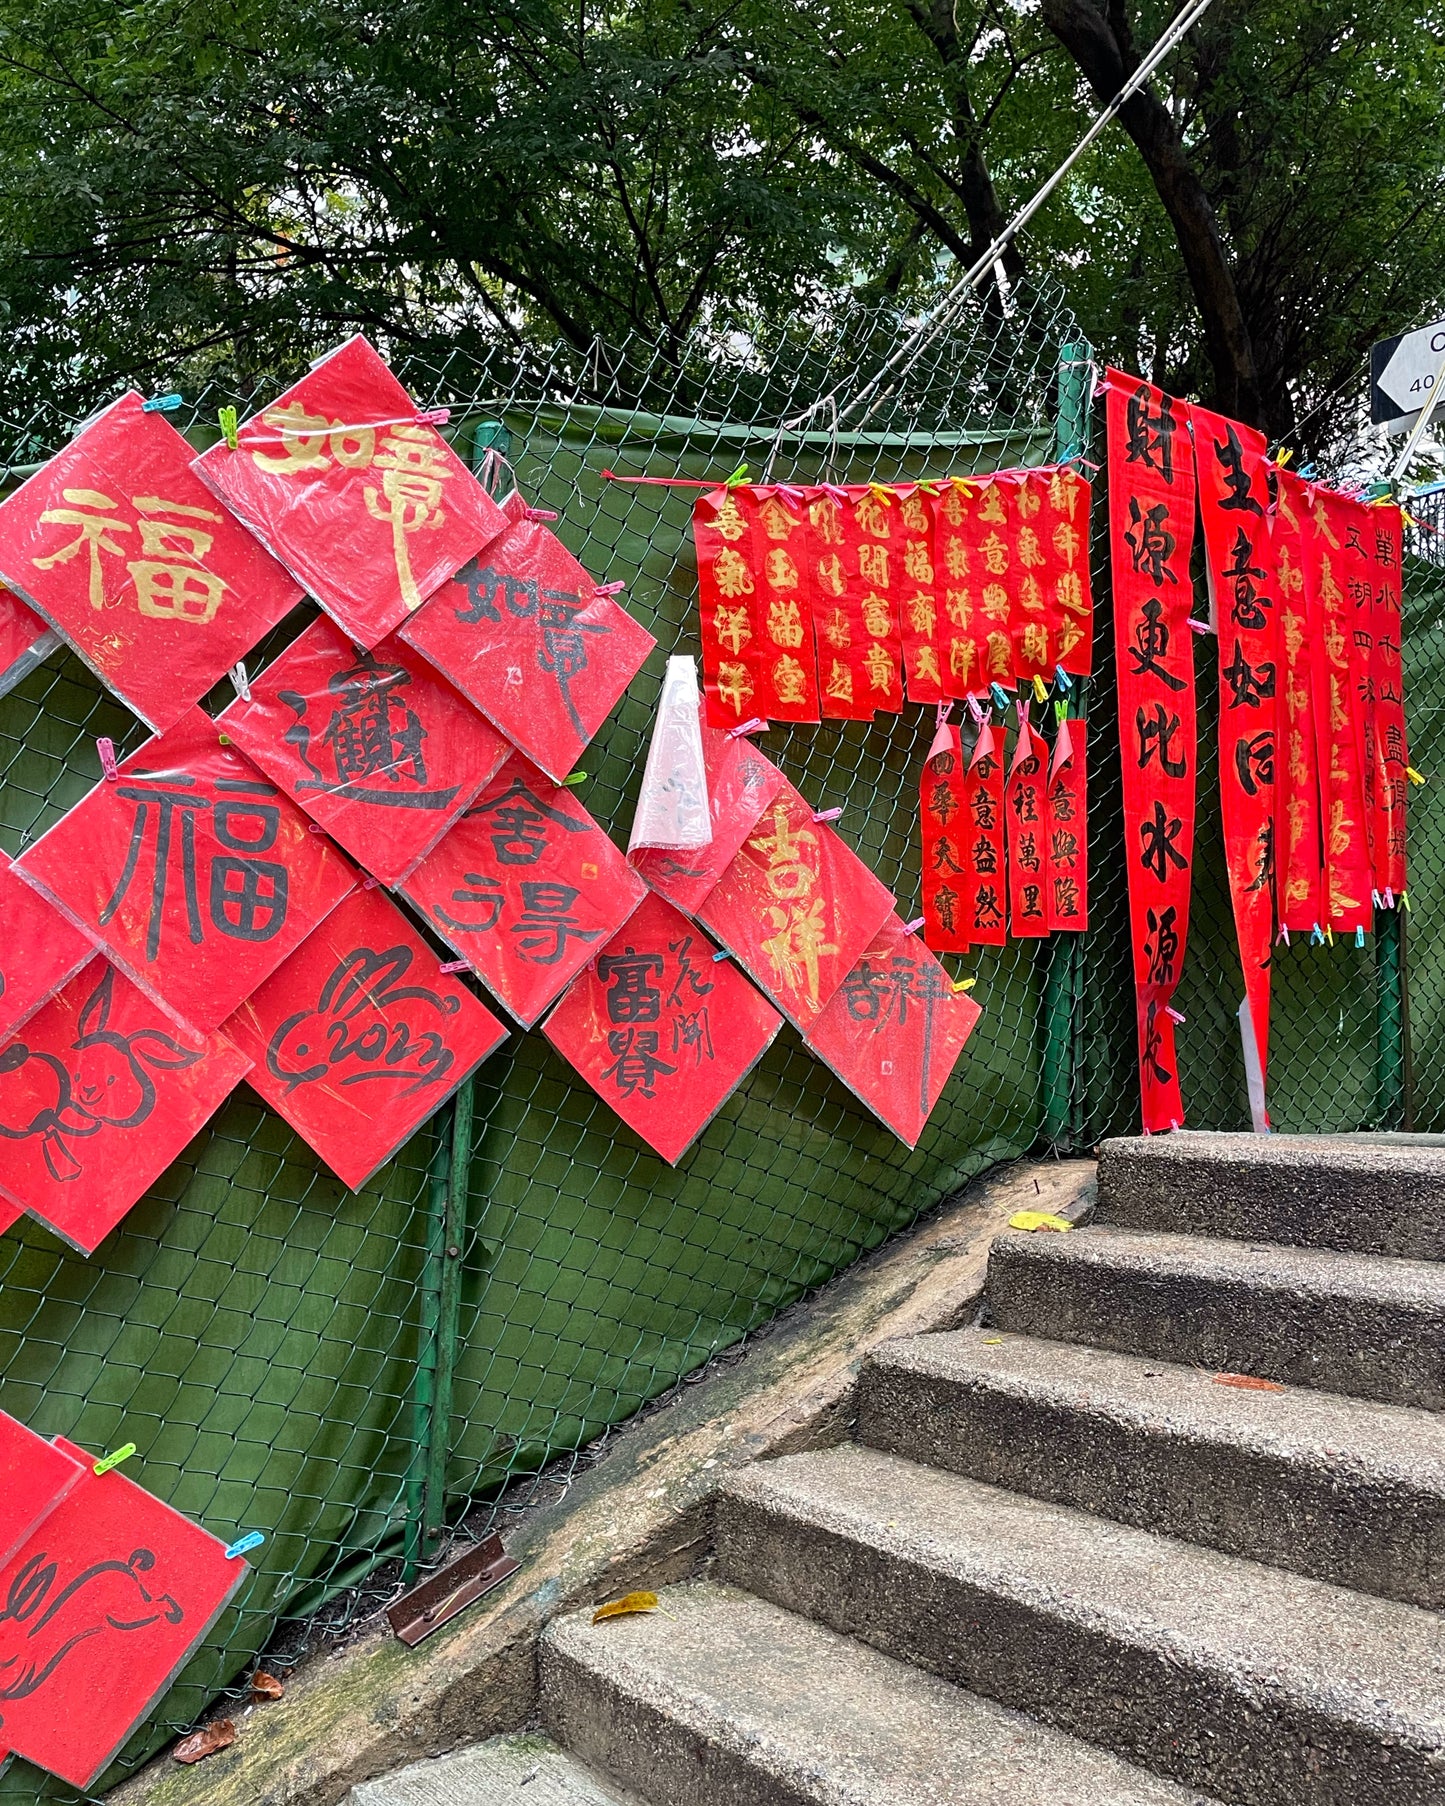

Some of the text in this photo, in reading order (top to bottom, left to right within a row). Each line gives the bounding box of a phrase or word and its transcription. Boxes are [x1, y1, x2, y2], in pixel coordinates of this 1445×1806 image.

[32, 488, 228, 625] 福
[252, 401, 454, 611] 如意
[755, 497, 806, 704] 金玉滿堂
[854, 495, 892, 697] 花開富貴
[977, 483, 1011, 677] 生意興隆
[1014, 482, 1049, 667] 和氣生財
[1047, 472, 1091, 662] 新年進步
[452, 557, 612, 746] 如意
[100, 769, 290, 962] 福
[748, 805, 838, 1001] 吉祥
[1048, 758, 1081, 918] 意興隆
[327, 1020, 456, 1085] 2023
[841, 956, 953, 1115] 吉祥
